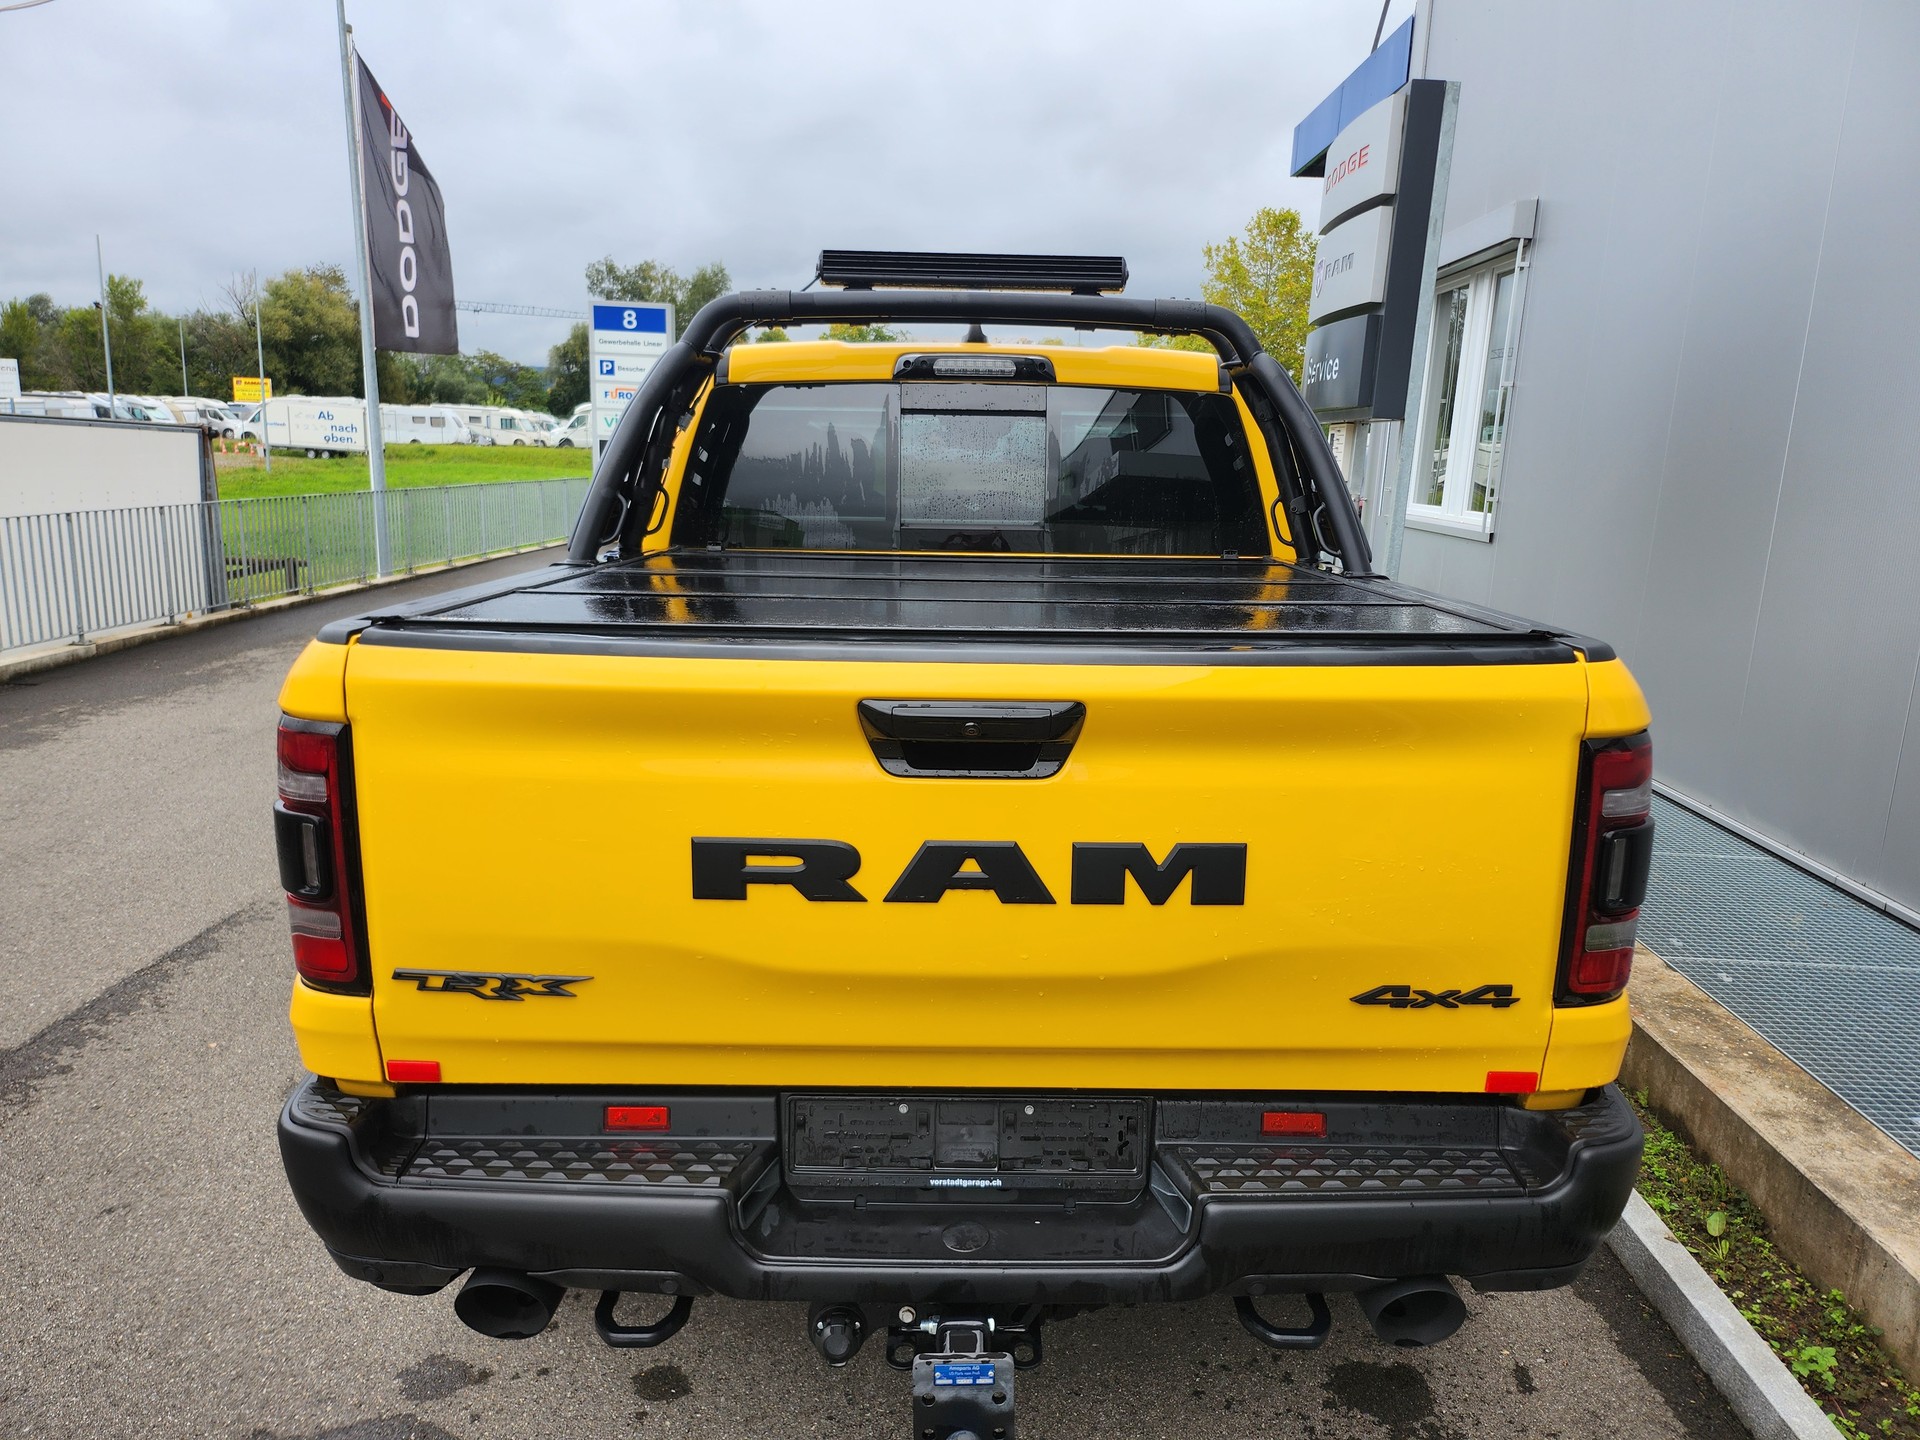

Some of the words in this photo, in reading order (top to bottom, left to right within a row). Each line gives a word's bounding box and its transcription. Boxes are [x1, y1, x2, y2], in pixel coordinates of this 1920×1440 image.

[1325, 144, 1370, 195] DODGE
[390, 108, 420, 339] DODGE
[1324, 252, 1355, 280] RAM
[622, 309, 638, 330] 8
[602, 361, 613, 374] P
[617, 365, 646, 373] Besucher
[1307, 353, 1340, 385] Service
[318, 411, 334, 421] Ab
[330, 423, 358, 434] nach
[323, 433, 357, 444] oben.
[691, 837, 1248, 906] RAM
[391, 967, 595, 1001] TRX
[1349, 984, 1521, 1009] 4x4
[929, 1178, 1002, 1188] vorstadtgarage.ch
